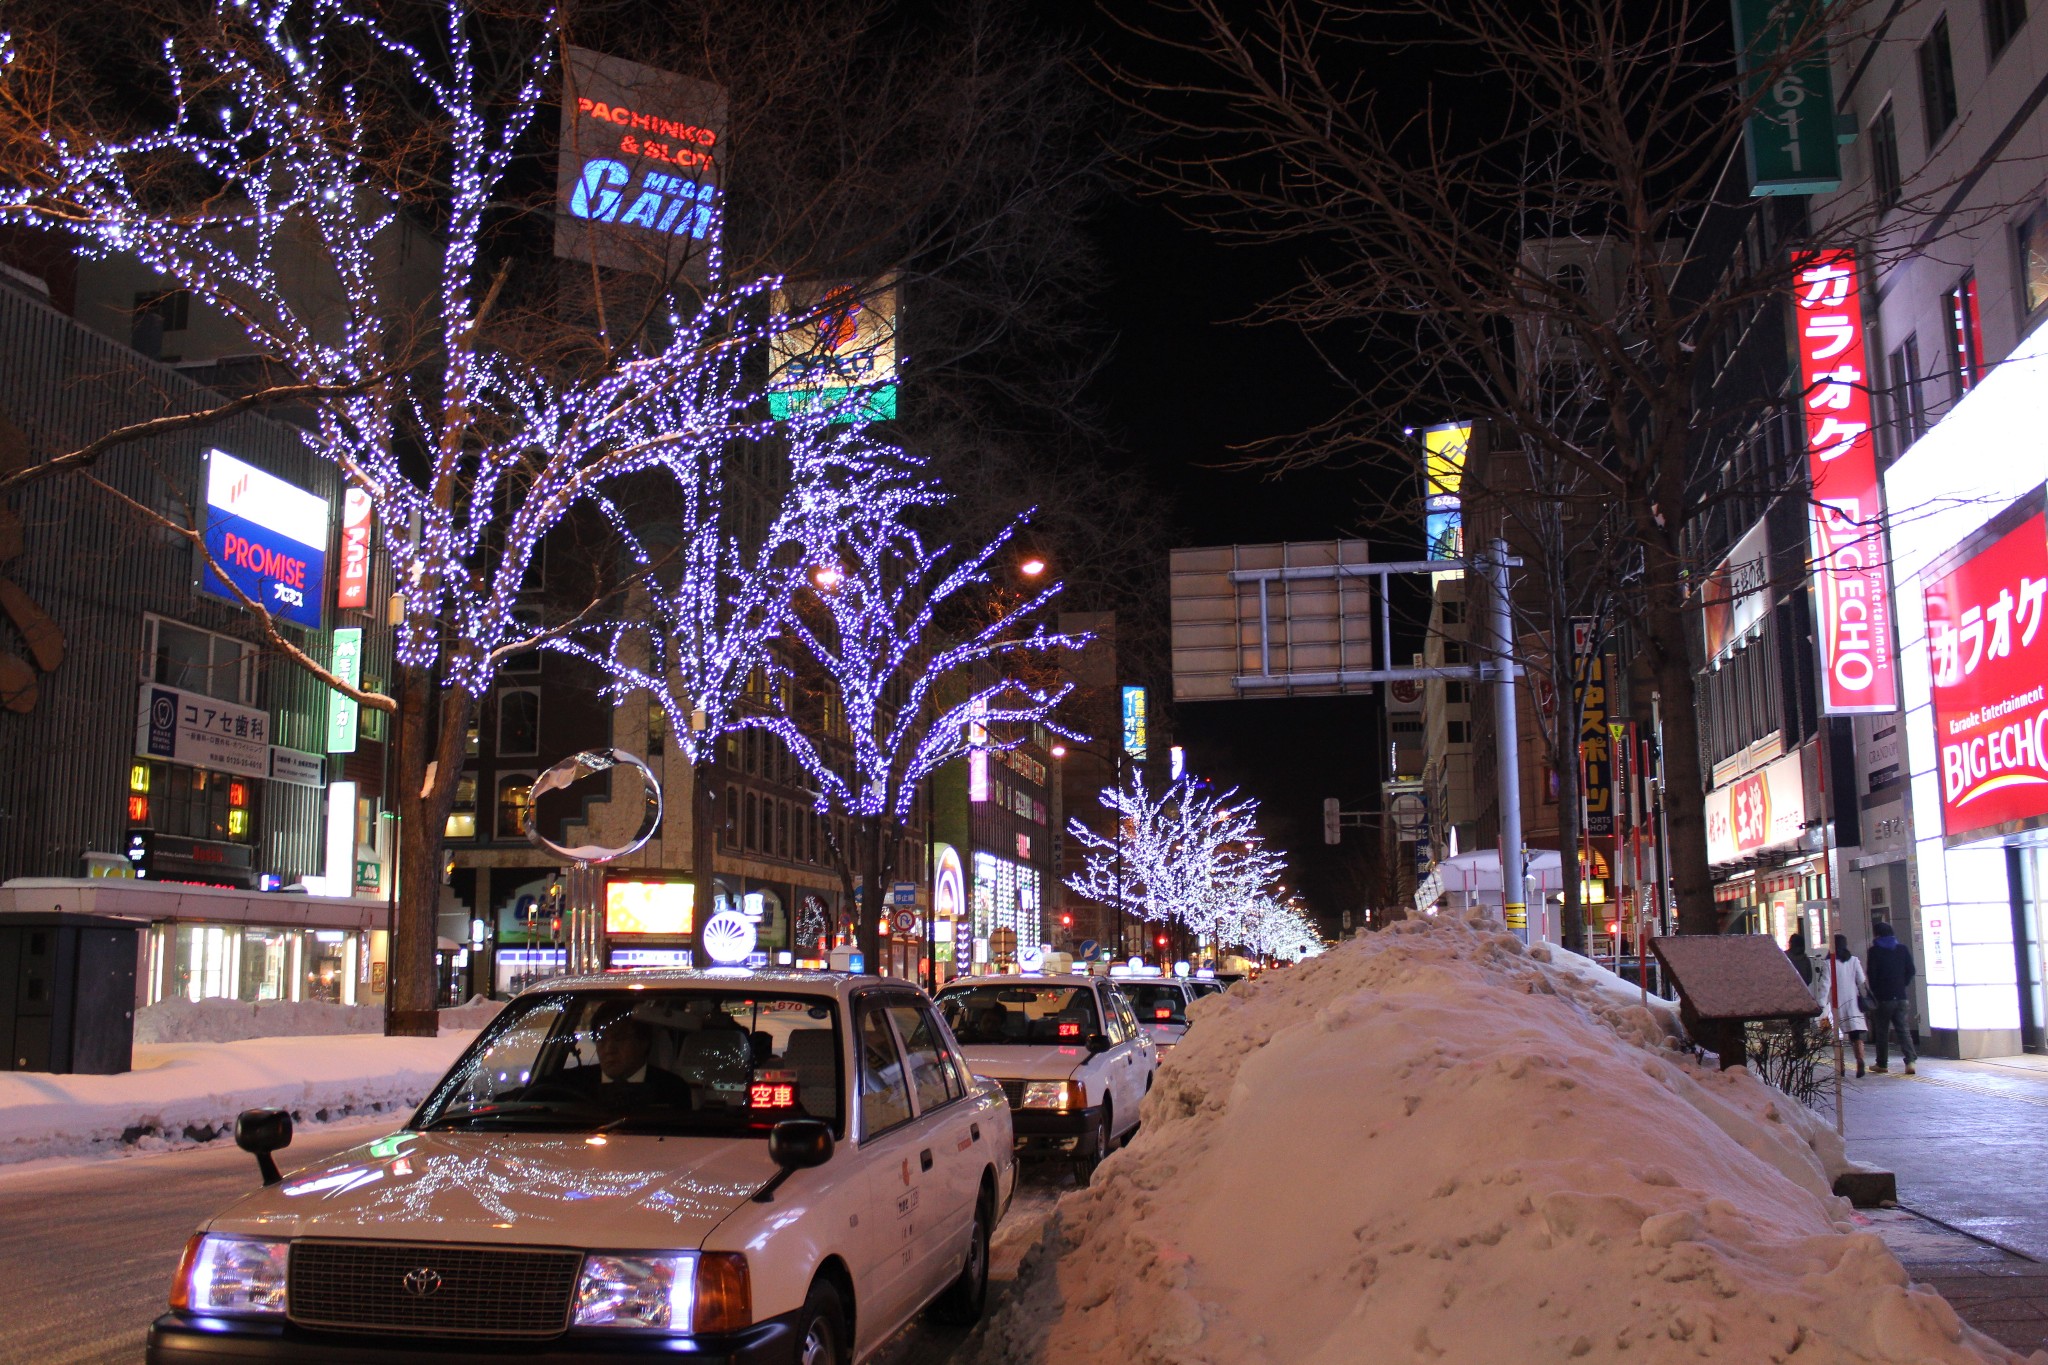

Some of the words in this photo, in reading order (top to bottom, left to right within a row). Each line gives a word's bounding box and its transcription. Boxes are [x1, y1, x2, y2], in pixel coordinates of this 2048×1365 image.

[578, 97, 716, 147] PACHINKO
[621, 135, 640, 155] &
[642, 171, 715, 203] MEGA
[1800, 263, 1867, 462] カラオケ
[345, 527, 366, 579] アコム
[1819, 497, 1863, 570] BIG
[224, 531, 307, 590] PROMISE
[345, 585, 361, 598] 4F
[1834, 579, 1874, 691] ECHO
[1869, 571, 1888, 670] Entertainment
[1934, 576, 2047, 688] カラオケ
[184, 704, 265, 742] コアセ歯科
[1949, 711, 1981, 736] Karaoke
[1981, 685, 2044, 723] Entertainment
[1942, 737, 1986, 804] BIG
[1586, 816, 1611, 825] PORTS
[1588, 824, 1609, 833] HOP
[751, 1085, 793, 1109] 空車
